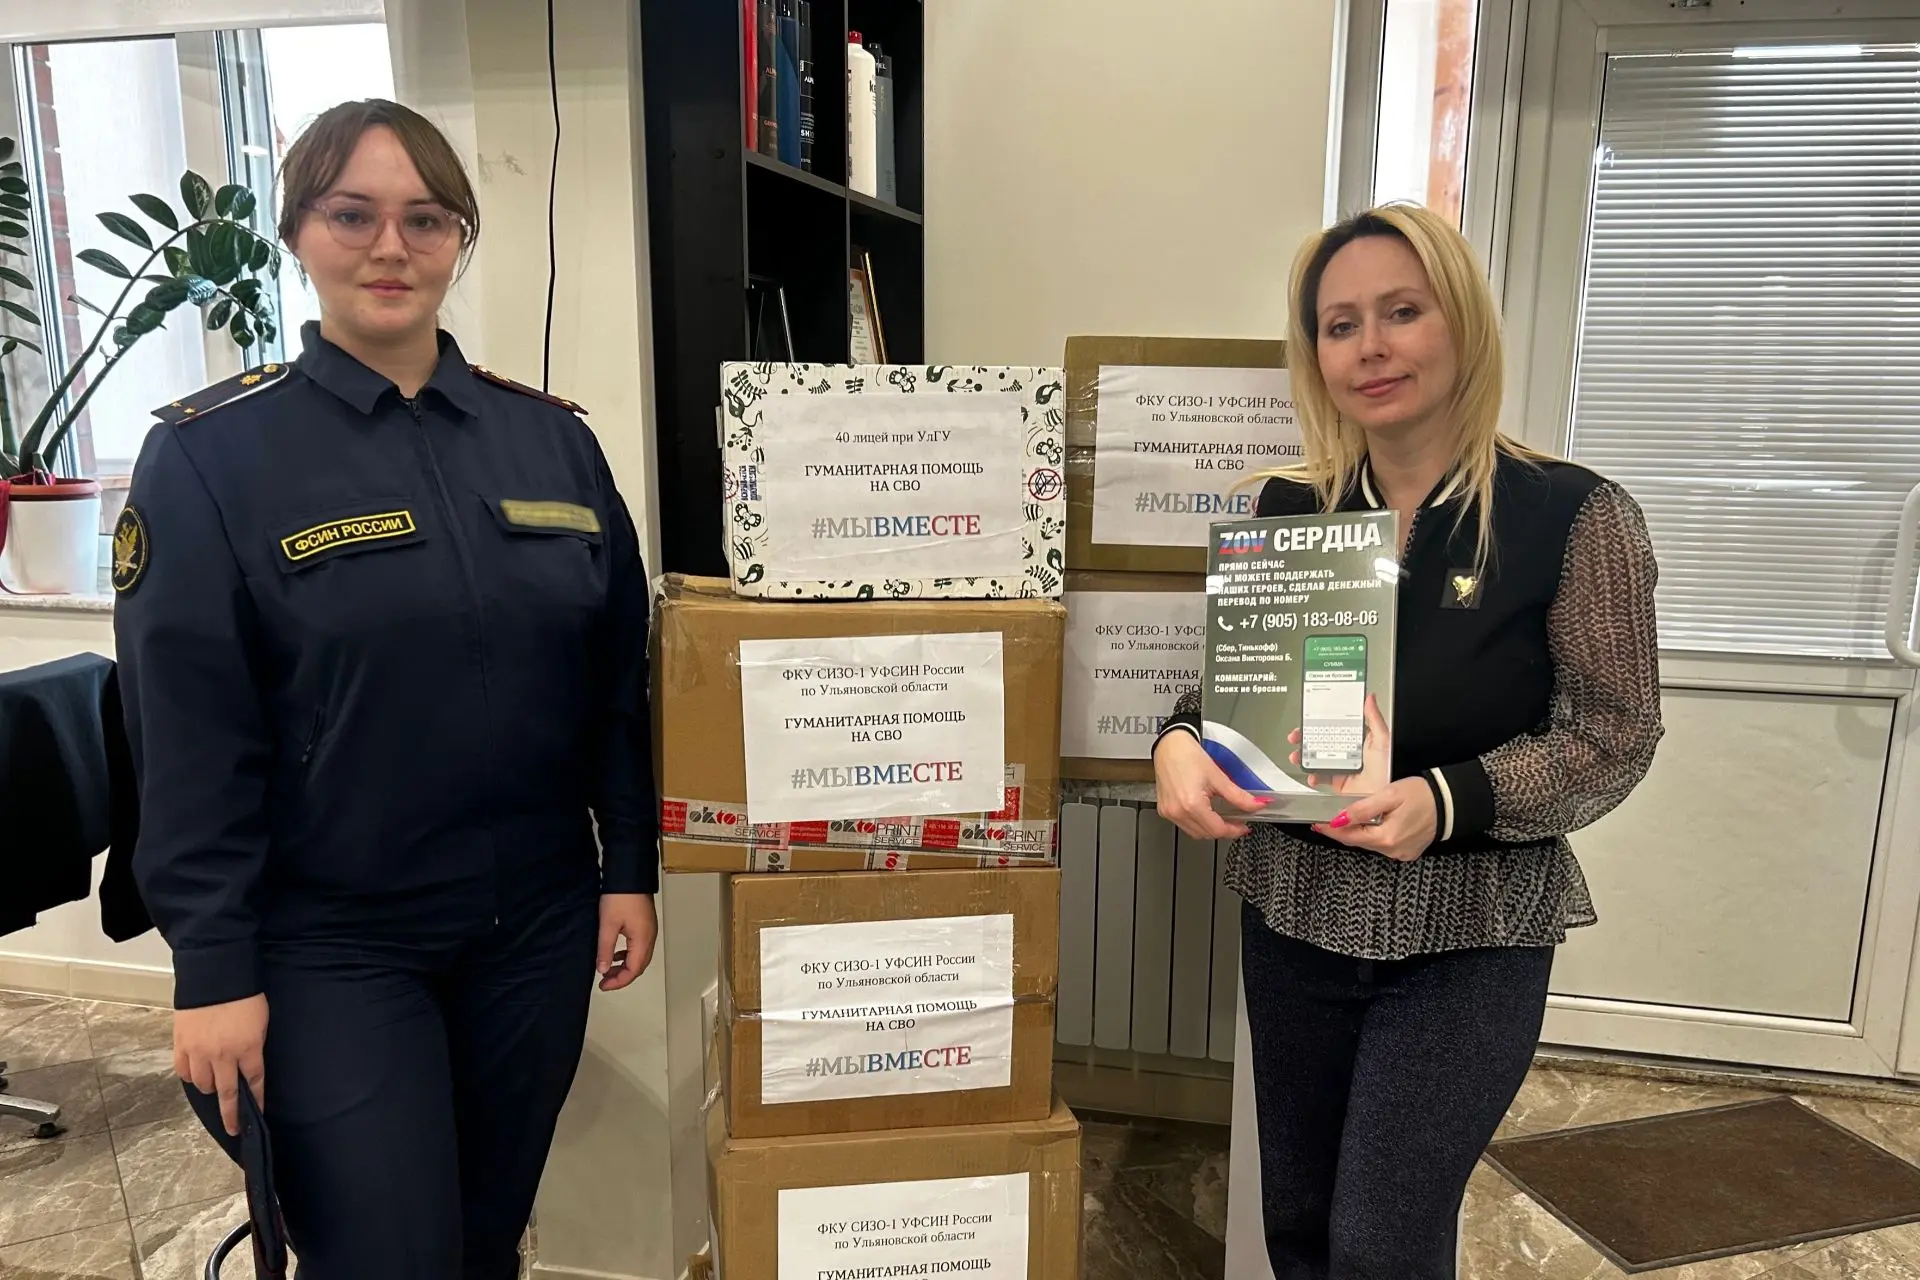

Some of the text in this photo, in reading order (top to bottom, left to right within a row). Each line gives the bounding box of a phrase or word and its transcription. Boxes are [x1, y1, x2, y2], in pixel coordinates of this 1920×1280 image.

[1135, 395, 1296, 409] ФКУ СИЗО-1 УФСИН Росс
[1151, 412, 1293, 425] по Ульяновской области
[835, 430, 951, 445] 40 лицей при УлГУ
[1134, 441, 1243, 456] ГУМАНИТАРНАЯ
[805, 463, 984, 478] ГУМАНИТАРНАЯ ПОМОЩЬ
[1195, 459, 1244, 471] НА СВО
[870, 479, 921, 492] НА СВО
[812, 514, 981, 540] #МЫВМЕСТЕ
[295, 517, 403, 552] ФСИН РОССИИ
[1218, 523, 1382, 555] ZOV СЕРДЦА
[1218, 559, 1286, 572] ПРЯМО СЕЙЧАС
[1234, 572, 1271, 582] МОЖЕТЕ
[1273, 569, 1335, 581] ПОДДЕРЖАТЬ
[1251, 584, 1287, 594] ГЕРОЕВ,
[1289, 582, 1325, 593] СДЕЛАВ
[1328, 580, 1382, 591] ДЕНЕЖНЫЙ
[1217, 595, 1310, 607] ПЕРЕВОД ПО НОМЕРУ
[1239, 610, 1379, 632] +7 (905) 183-08-06
[1095, 625, 1206, 637] ФКУ СИЗО-1 УФС
[1111, 642, 1124, 651] по
[1128, 639, 1199, 652] Ульяновской
[1216, 643, 1238, 653] (Сбер,
[1238, 643, 1278, 653] Тинькофф)
[1215, 654, 1241, 663] Оксана
[1241, 653, 1284, 663] Викторовна
[782, 664, 965, 681] ФКУ СИЗО-1 УФСИН России
[1094, 668, 1200, 680] ГУМАНИТАРНАЯ
[1214, 672, 1278, 682] КОММЕНТАРИЙ:
[801, 681, 949, 697] по Ульяновской области
[1153, 684, 1171, 694] НА
[1214, 684, 1288, 694] Своих не бросаем
[785, 710, 967, 729] ГУМАНИТАРНАЯ ПОМОЩЬ
[851, 729, 902, 742] НА СВО
[791, 761, 963, 789] #МЫВМЕСТЕ
[735, 826, 781, 839] SERVICE
[874, 834, 921, 846] SERVICE
[1003, 841, 1046, 852] SERVICE
[800, 954, 976, 975] ФКУ СИЗО-1 УФСИН России
[817, 971, 960, 990] по Ульяновской области
[801, 1000, 978, 1020] ГУМАНИТАРНАЯ ПОМОЩЬ
[865, 1018, 916, 1032] НА СВО
[805, 1045, 973, 1078] #МЫВМЕСТЕ
[817, 1214, 993, 1235] ФКУ СИЗО-1 УФСИН России
[834, 1231, 976, 1250] по Ульяновской области
[817, 1257, 992, 1280] ГУМАНИТАРНАЯ ПОМОЩЬ
